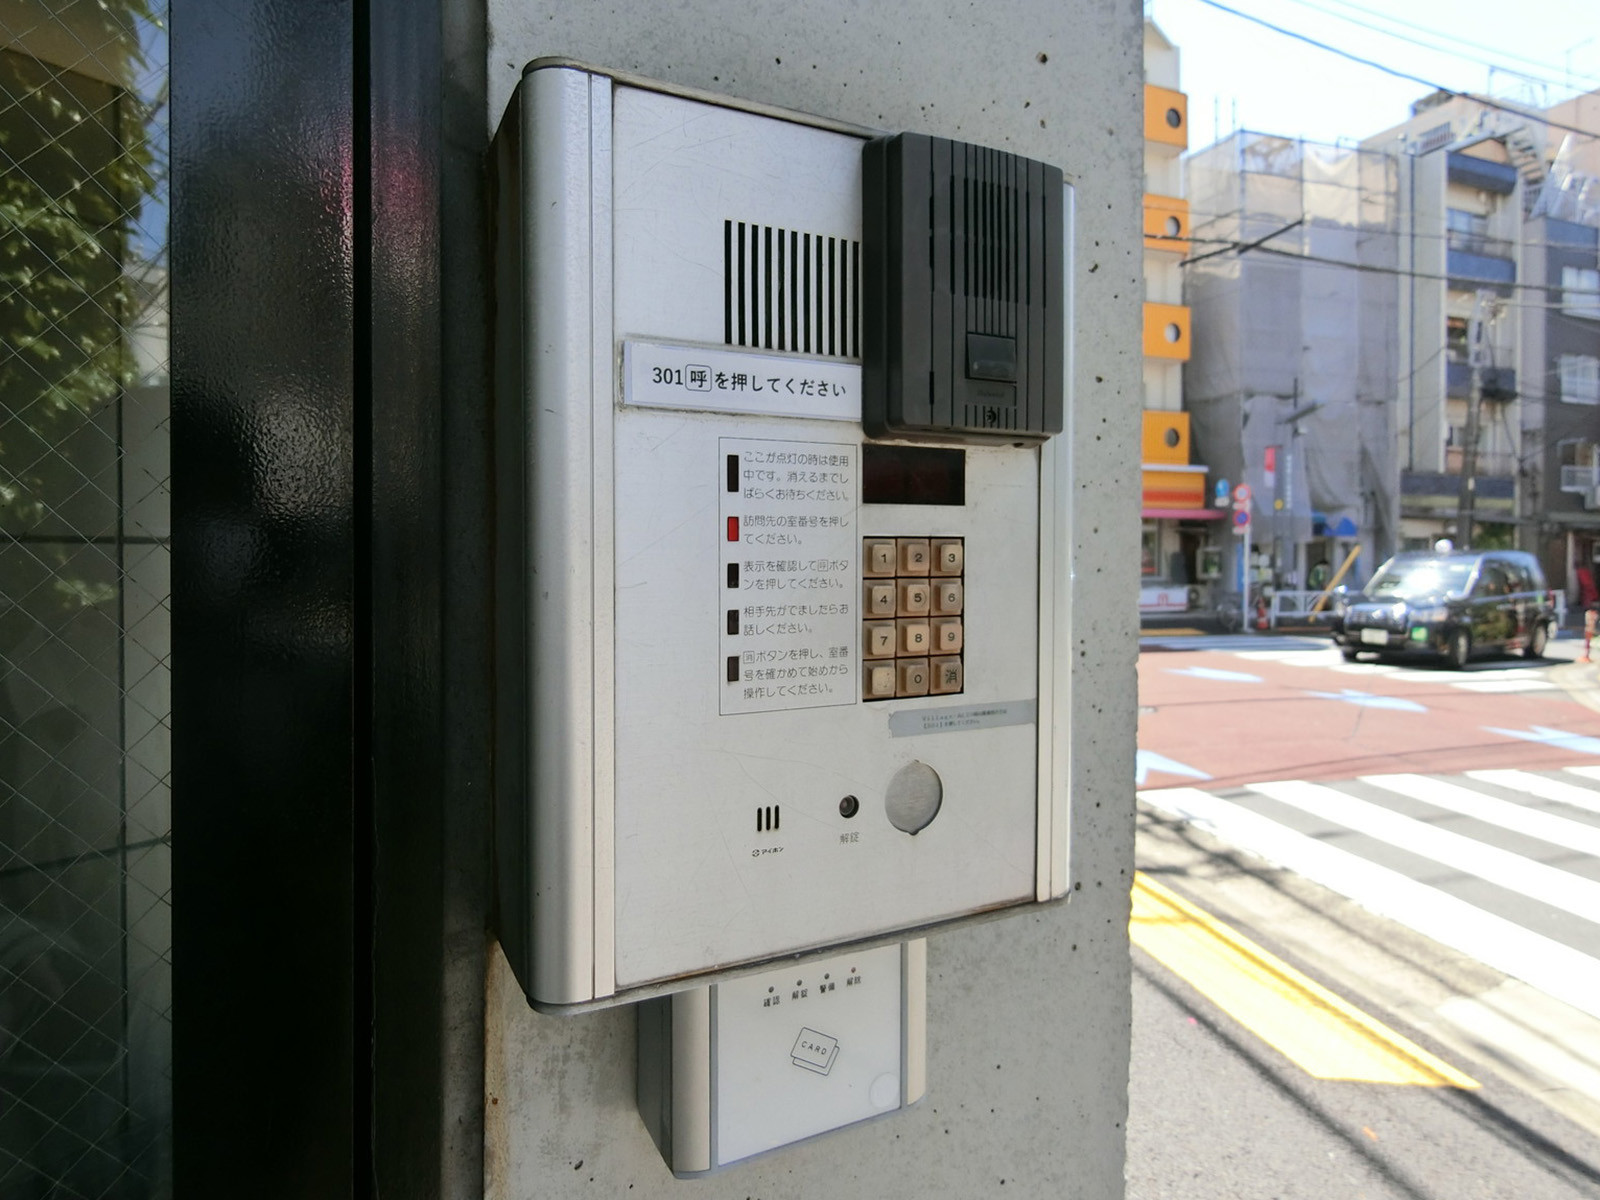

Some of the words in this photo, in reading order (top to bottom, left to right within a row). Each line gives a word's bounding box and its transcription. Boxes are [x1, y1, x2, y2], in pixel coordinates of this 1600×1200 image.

[652, 364, 847, 397] 301呼を押してください
[743, 451, 849, 467] ここが点灯の時は使用
[743, 470, 849, 484] 中です。消えるまでし
[743, 515, 849, 528] 訪問先の室番号を押し
[743, 533, 802, 545] てください。
[880, 553, 887, 563] 1
[914, 553, 923, 563] 2
[948, 553, 956, 563] 3
[743, 577, 844, 590] ンを押してください。
[880, 595, 888, 605] 4
[914, 593, 922, 603] 5
[948, 593, 956, 602] 6
[743, 603, 849, 618] 相手先がでましたらお
[743, 623, 813, 636] 話しください。
[880, 636, 888, 646] 7
[914, 633, 923, 643] 8
[948, 632, 956, 642] 9
[743, 664, 849, 682] 号を確かめて始めから
[743, 683, 833, 700] 操作してください。
[801, 1041, 827, 1055] CARD
